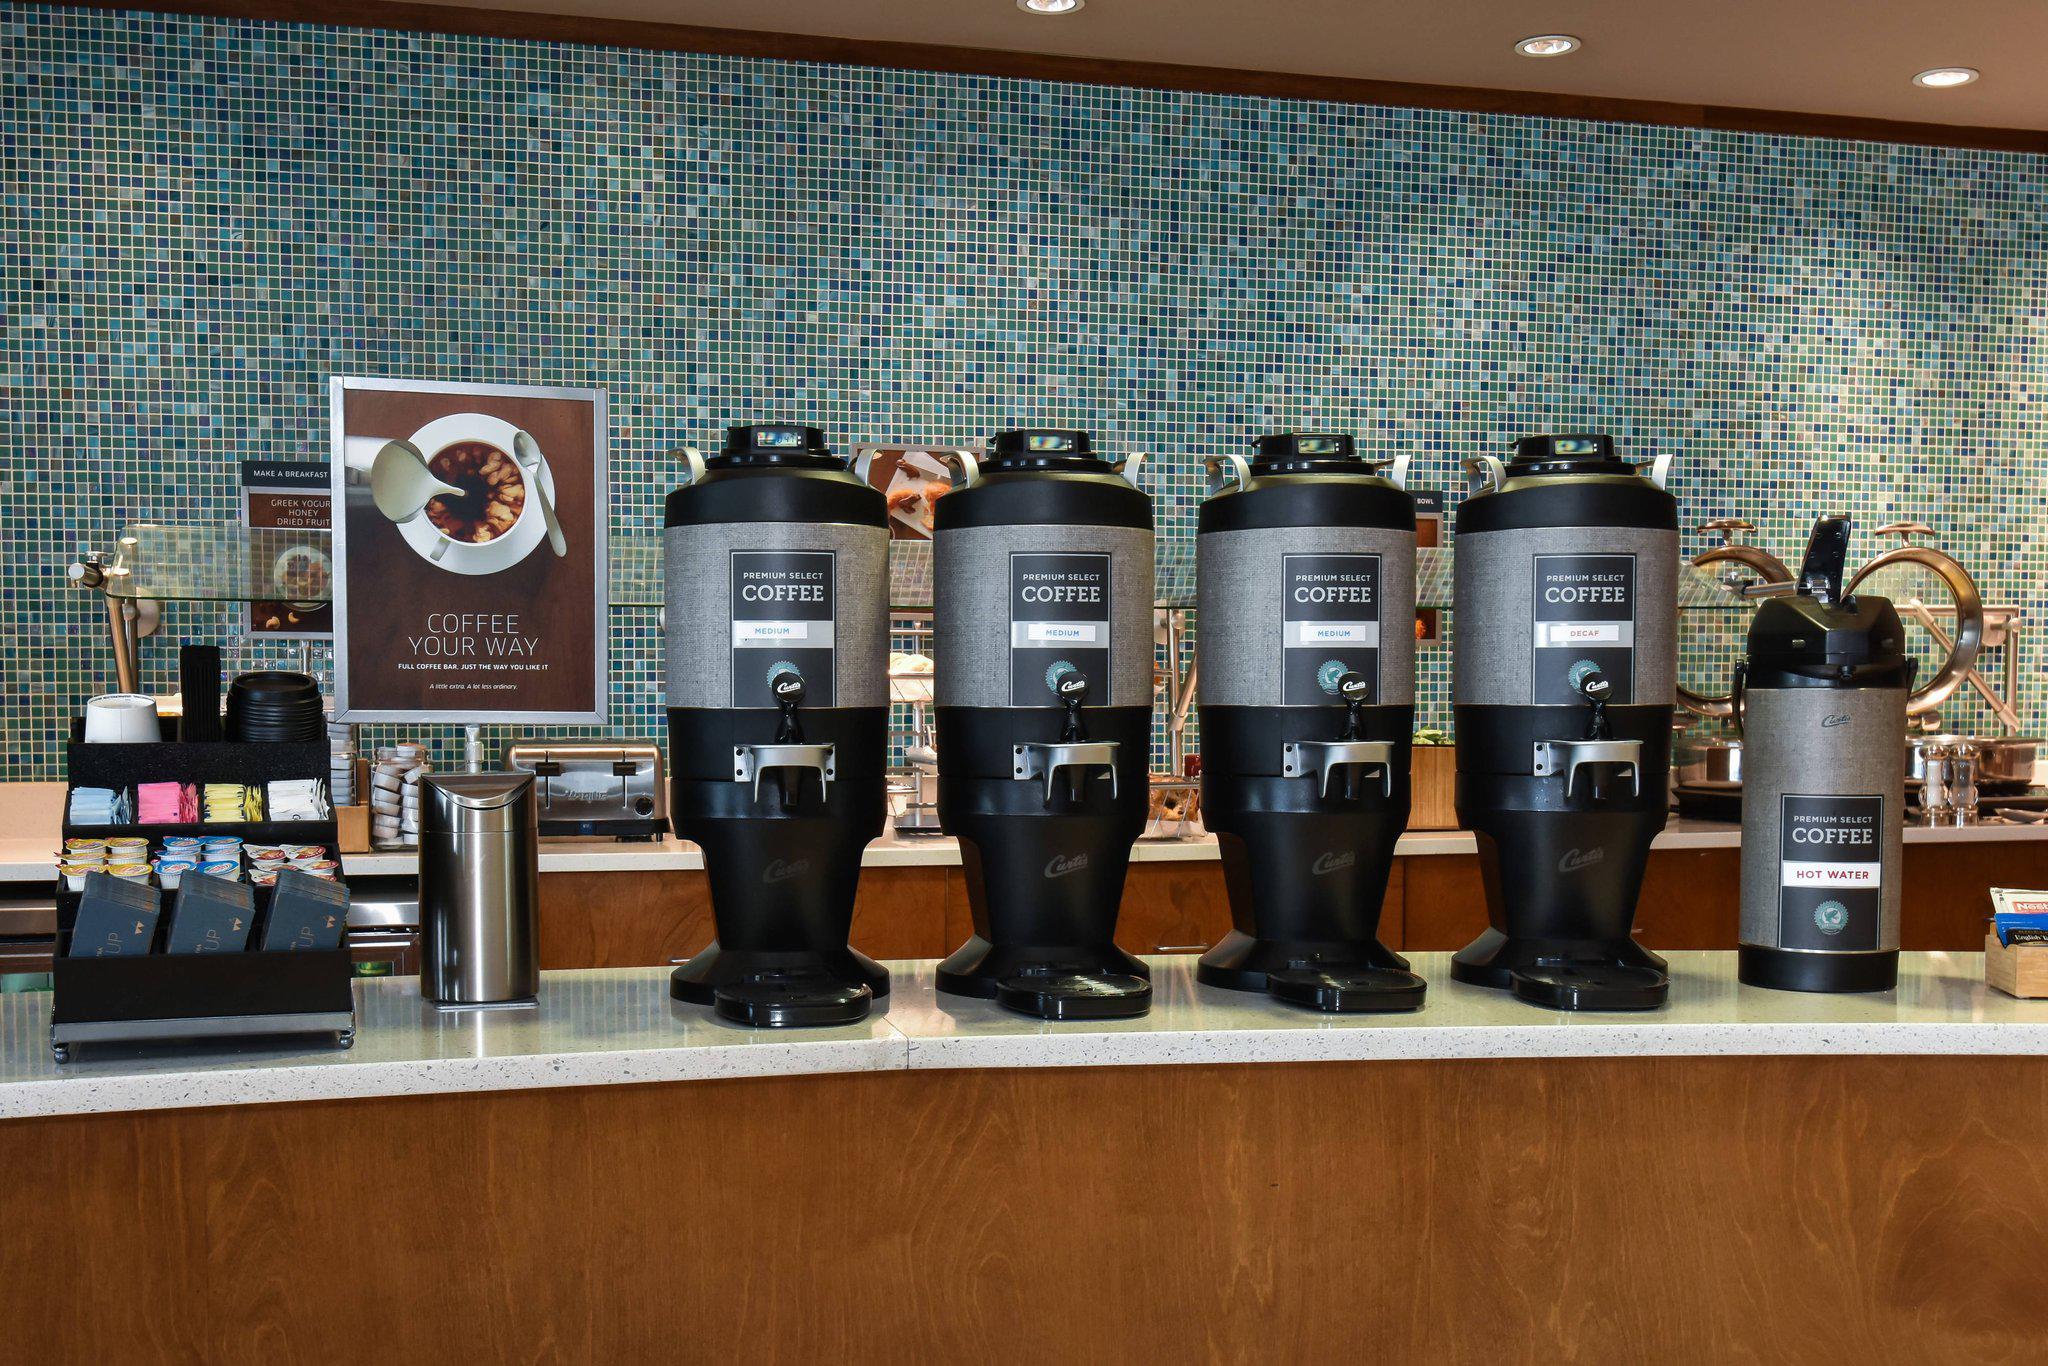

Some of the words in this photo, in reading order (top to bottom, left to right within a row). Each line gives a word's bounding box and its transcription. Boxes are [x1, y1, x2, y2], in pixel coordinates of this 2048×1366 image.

[285, 470, 329, 478] BREAKFAST
[270, 499, 299, 507] GREEK
[301, 500, 331, 508] YOGUR
[288, 509, 319, 517] HONEY
[276, 517, 303, 526] DRIED
[305, 518, 331, 526] FRUIT
[789, 572, 824, 580] SELECT
[1022, 573, 1065, 581] PREMIUM
[1068, 573, 1100, 581] SELECT
[1295, 574, 1337, 582] PREMIUM
[1339, 574, 1371, 582] SELECT
[1546, 574, 1589, 582] PREMIUM
[1591, 574, 1625, 582] SELECT
[742, 584, 824, 602] COFFEE
[1021, 585, 1101, 603] COFFEE
[1294, 586, 1371, 603] COFFEE
[1545, 586, 1625, 603] COFFEE
[427, 613, 520, 634] COFFEE
[754, 627, 790, 635] MEDIUM
[1045, 629, 1080, 637] MEDIUM
[408, 636, 476, 656] YOUR
[485, 637, 539, 656] WAY
[1793, 815, 1837, 823] PREMIUM
[1792, 827, 1873, 844] COFFEE
[1796, 870, 1822, 879] HOT
[1827, 870, 1869, 879] WATER
